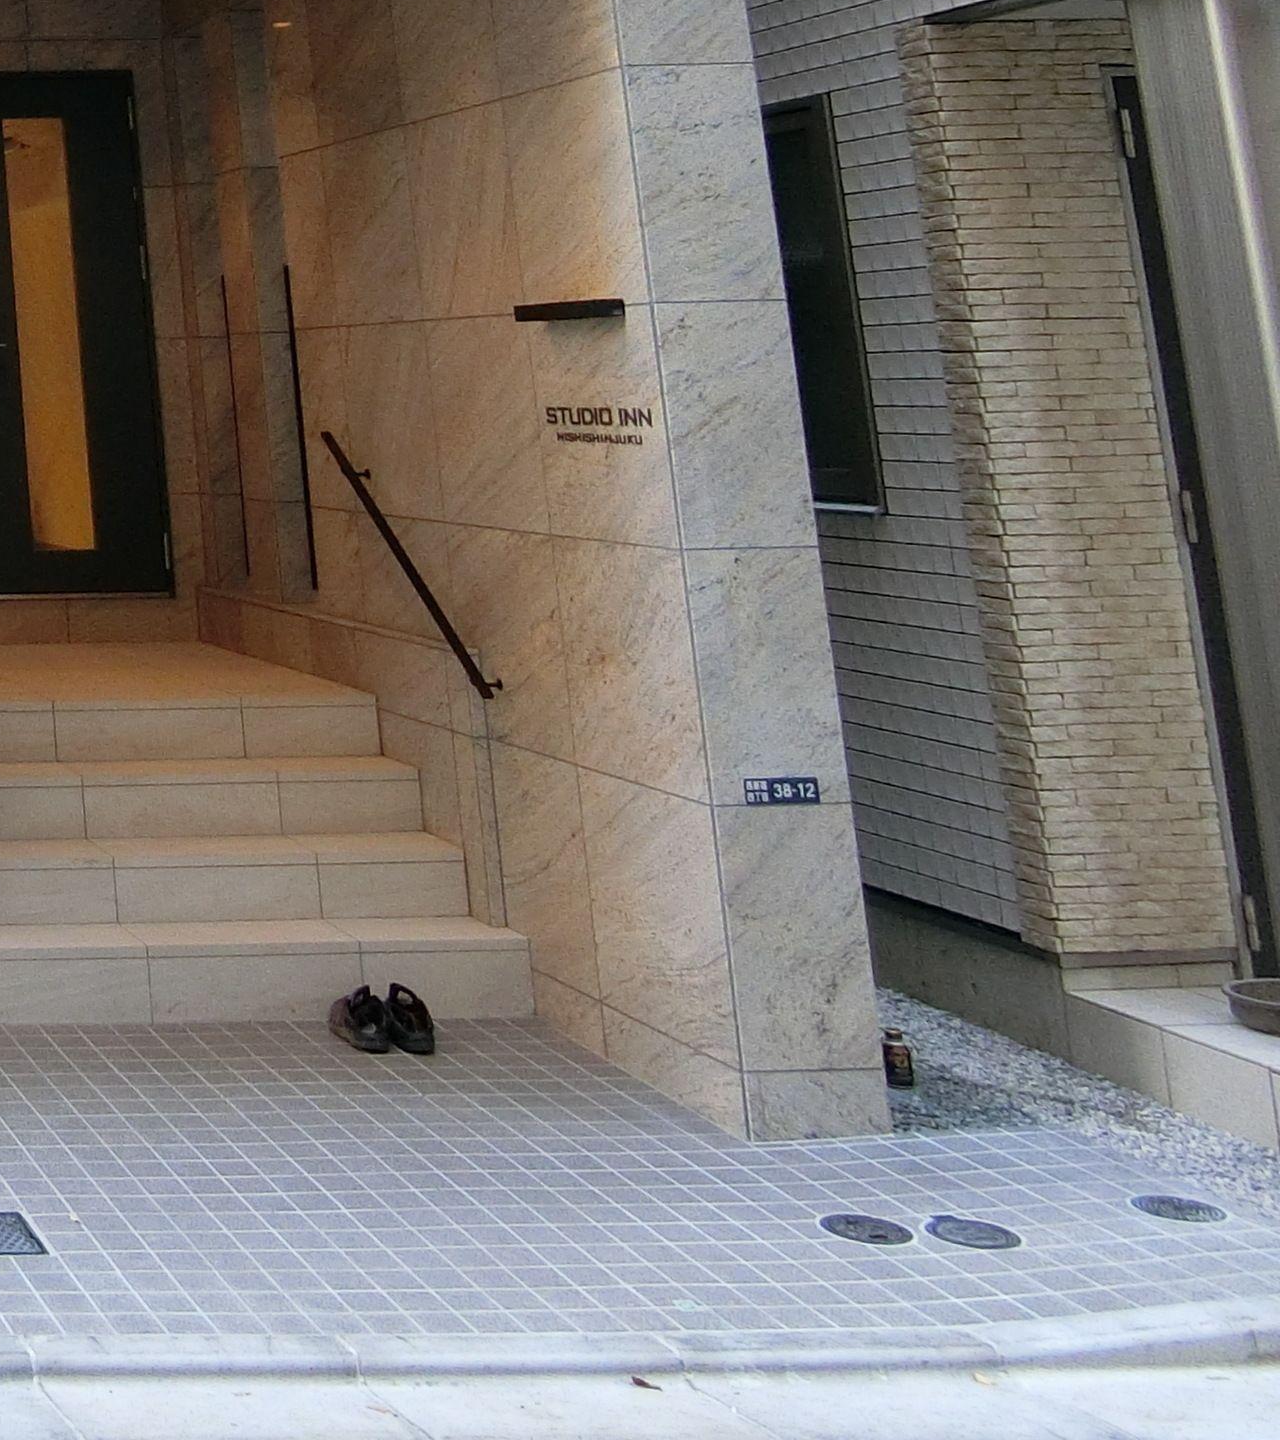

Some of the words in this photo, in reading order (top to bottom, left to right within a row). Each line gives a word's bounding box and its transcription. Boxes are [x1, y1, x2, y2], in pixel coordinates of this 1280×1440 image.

[546, 407, 613, 426] STUDIO
[618, 408, 653, 428] INN
[557, 432, 643, 445] NISHISHINJUKU
[773, 783, 816, 798] 38-12
